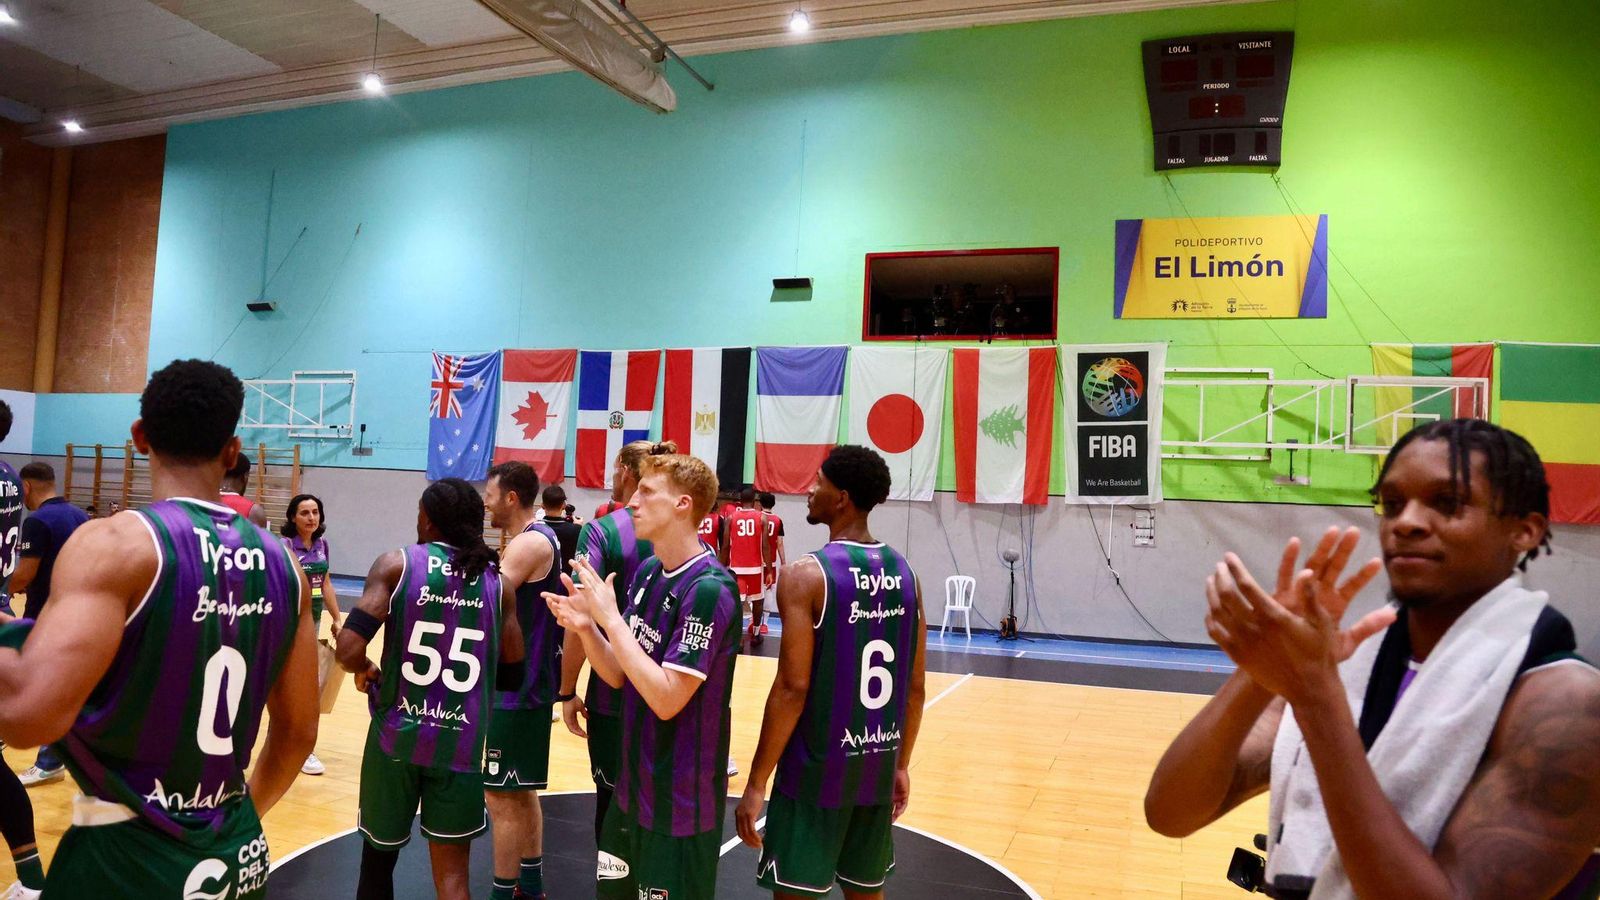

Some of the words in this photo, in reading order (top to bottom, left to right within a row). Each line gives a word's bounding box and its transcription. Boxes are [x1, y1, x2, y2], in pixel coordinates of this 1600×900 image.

[1168, 45, 1191, 54] LOCAL
[1238, 41, 1271, 50] VISITANTE
[1175, 237, 1263, 247] POLIDEPORTIVO
[1155, 256, 1180, 278] El
[1190, 253, 1284, 278] Limón
[1089, 434, 1137, 458] FIBA
[1085, 478, 1097, 487] We
[1097, 478, 1109, 487] Are
[1109, 478, 1142, 487] Basketball
[736, 518, 755, 537] 30
[0, 526, 18, 578] 3
[193, 527, 265, 575] Tyson
[848, 567, 902, 596] Taylor
[681, 628, 710, 650] laga
[401, 620, 485, 692] 55
[859, 639, 895, 710] 6
[196, 645, 247, 756] 0
[397, 696, 471, 725] Andalucía
[841, 721, 901, 748] Andalucía
[238, 832, 267, 864] COS
[239, 859, 264, 883] DEL
[599, 858, 627, 872] adesa
